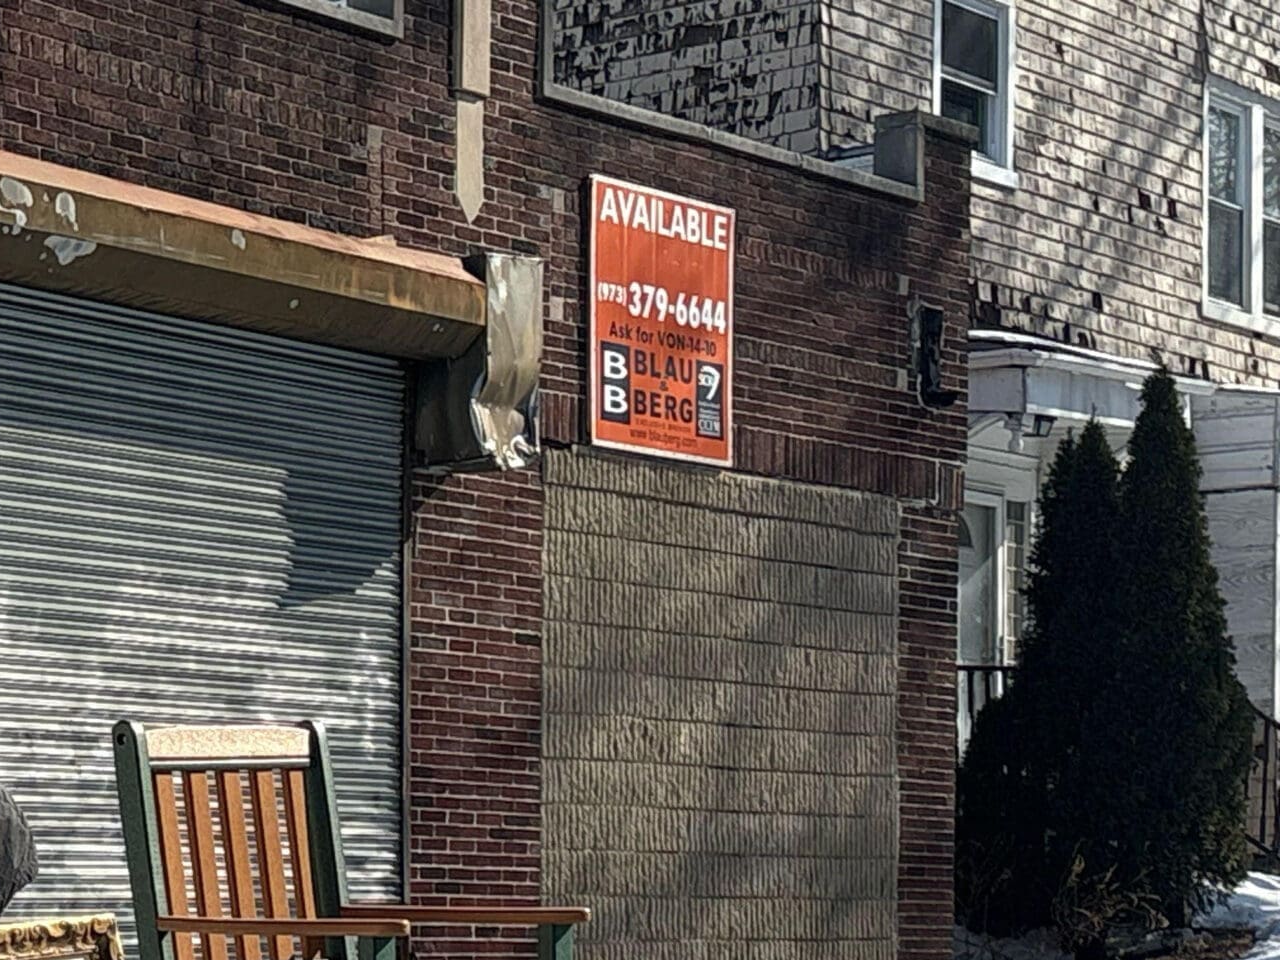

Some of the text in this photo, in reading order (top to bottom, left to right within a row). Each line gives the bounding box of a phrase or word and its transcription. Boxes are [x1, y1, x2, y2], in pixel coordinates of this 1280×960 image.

[600, 187, 727, 250] AVAILABLE
[598, 281, 726, 335] (973) 379-6644
[609, 320, 632, 340] Ask
[636, 325, 654, 344] for
[603, 350, 628, 379] B
[634, 348, 693, 385] BLAU
[603, 384, 628, 414] B
[634, 389, 693, 424] BERG
